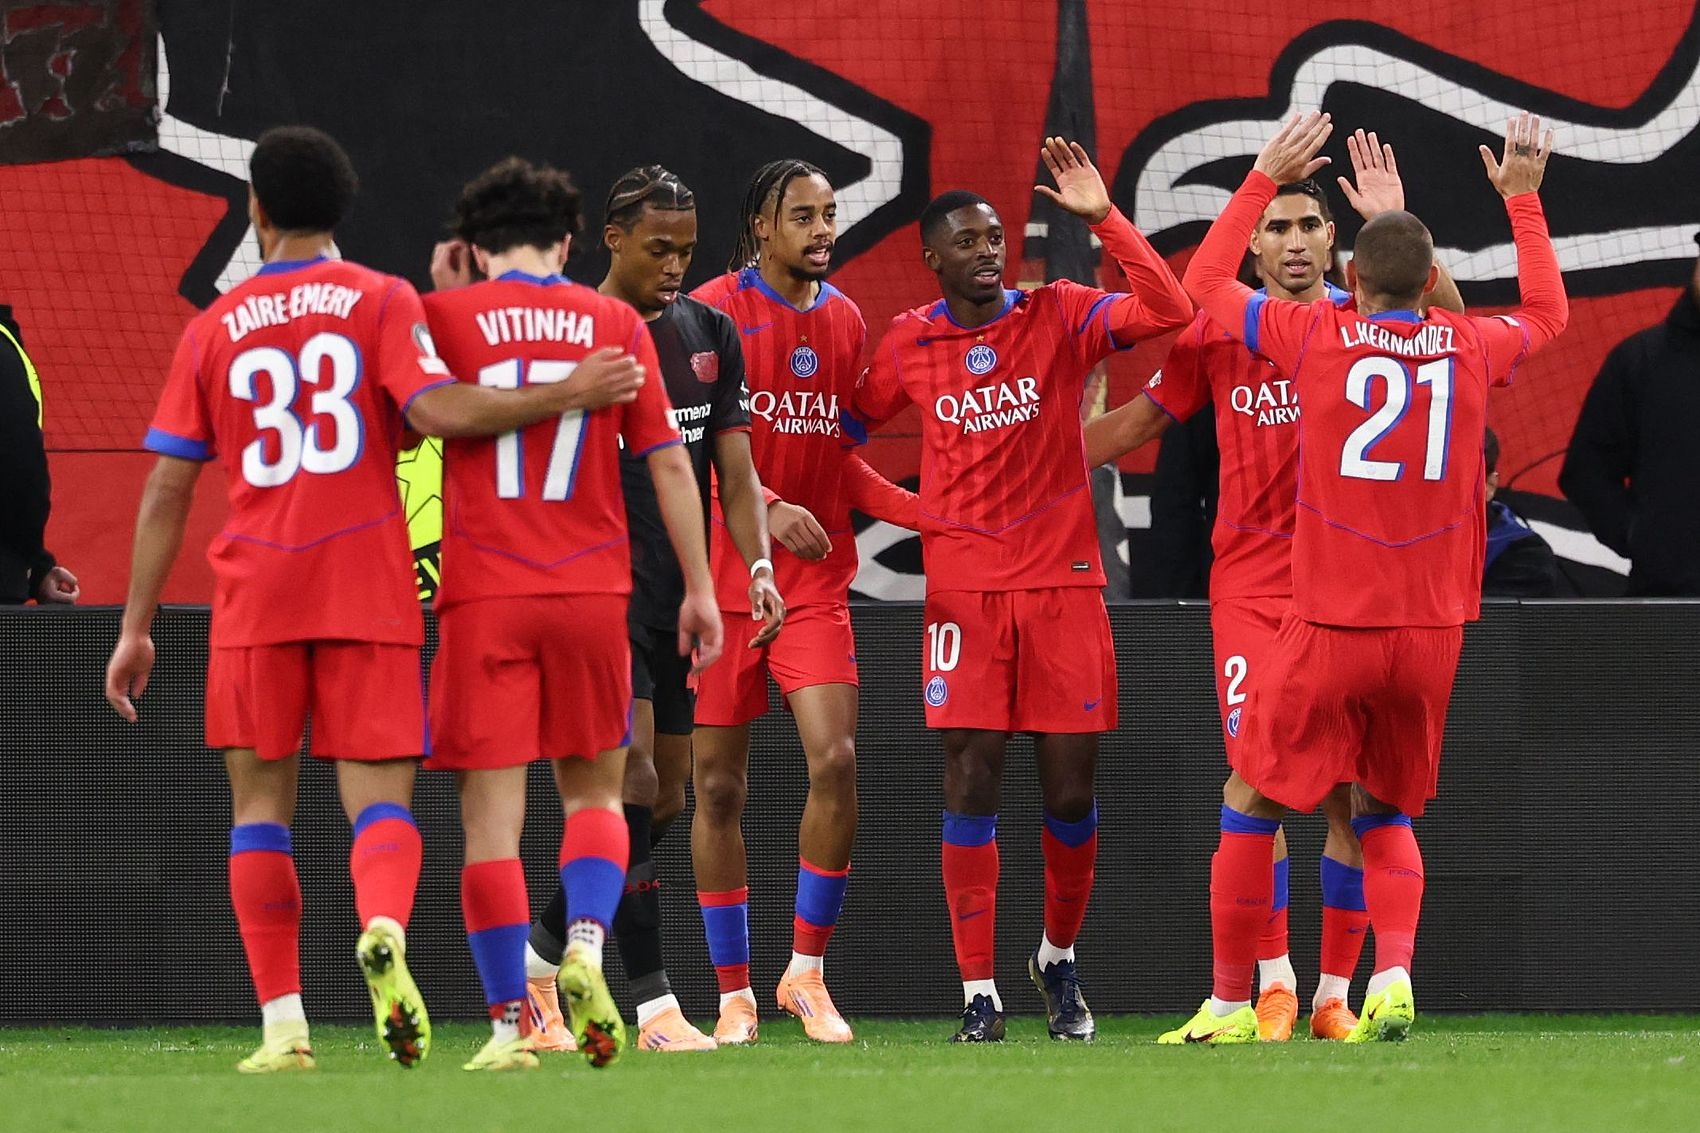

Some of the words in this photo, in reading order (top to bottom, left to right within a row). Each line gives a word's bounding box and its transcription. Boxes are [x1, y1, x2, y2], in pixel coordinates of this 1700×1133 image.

[475, 307, 595, 349] VITINHA
[1340, 321, 1457, 356] L.HERNANDEZ
[228, 331, 365, 488] 33
[936, 377, 1040, 425] QATAR
[963, 403, 1040, 435] AIRWAYS
[1231, 380, 1298, 416] QAT
[1257, 406, 1301, 427] AIRW
[1339, 355, 1455, 481] 21
[479, 357, 591, 502] 17
[772, 417, 840, 438] AIRWAYS
[928, 622, 961, 671] 10
[1224, 655, 1248, 706] 2
